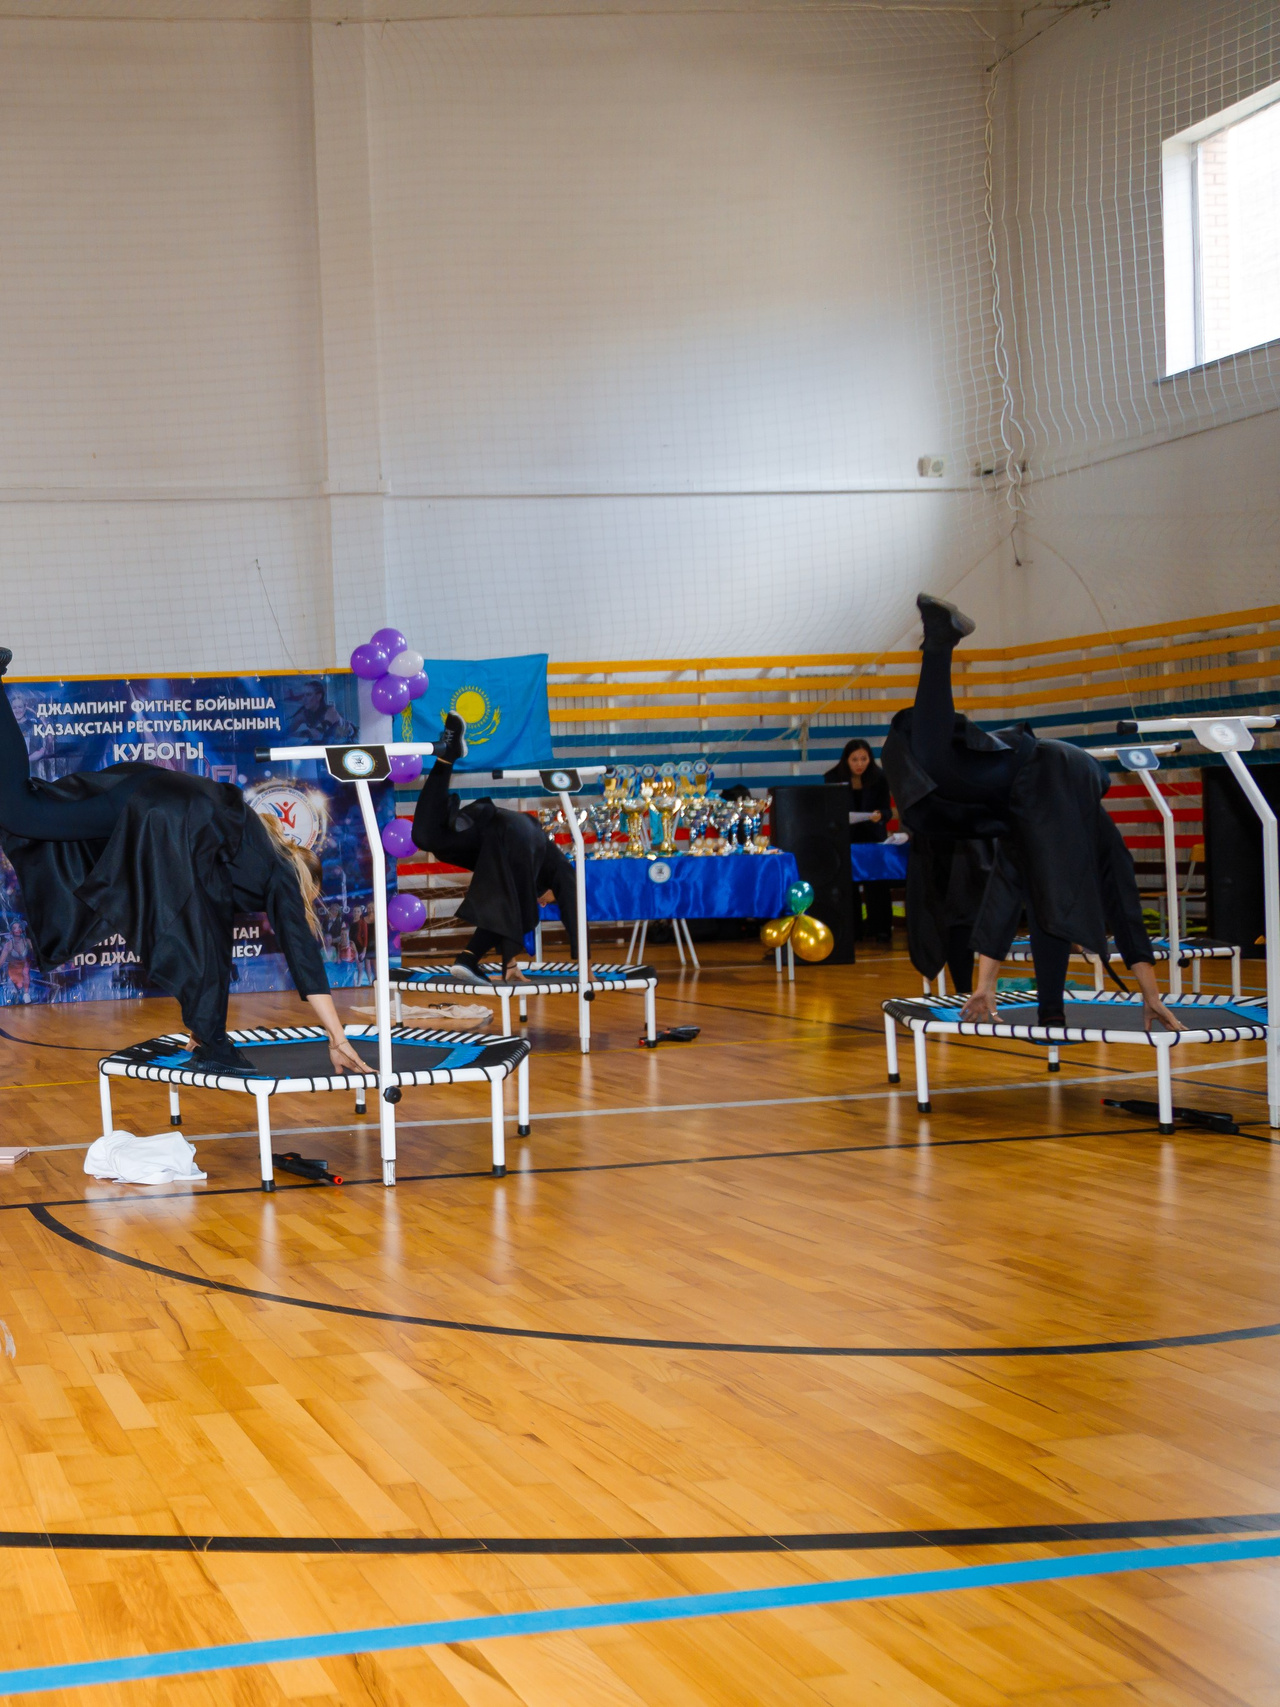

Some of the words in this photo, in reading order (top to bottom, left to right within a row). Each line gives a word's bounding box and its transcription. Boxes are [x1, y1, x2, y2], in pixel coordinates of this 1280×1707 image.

[37, 701, 127, 718] ДЖАМПИНГ
[130, 699, 192, 713] ФИТНЕС
[195, 696, 276, 712] БОЙЫНША
[33, 721, 123, 738] ҚАЗАҚСТАН
[127, 716, 281, 734] РЕСПУБЛИКАСЫНЫҢ
[113, 742, 204, 761] КУБОГЫ
[74, 953, 98, 966] ПО
[100, 951, 141, 966] ДЖА
